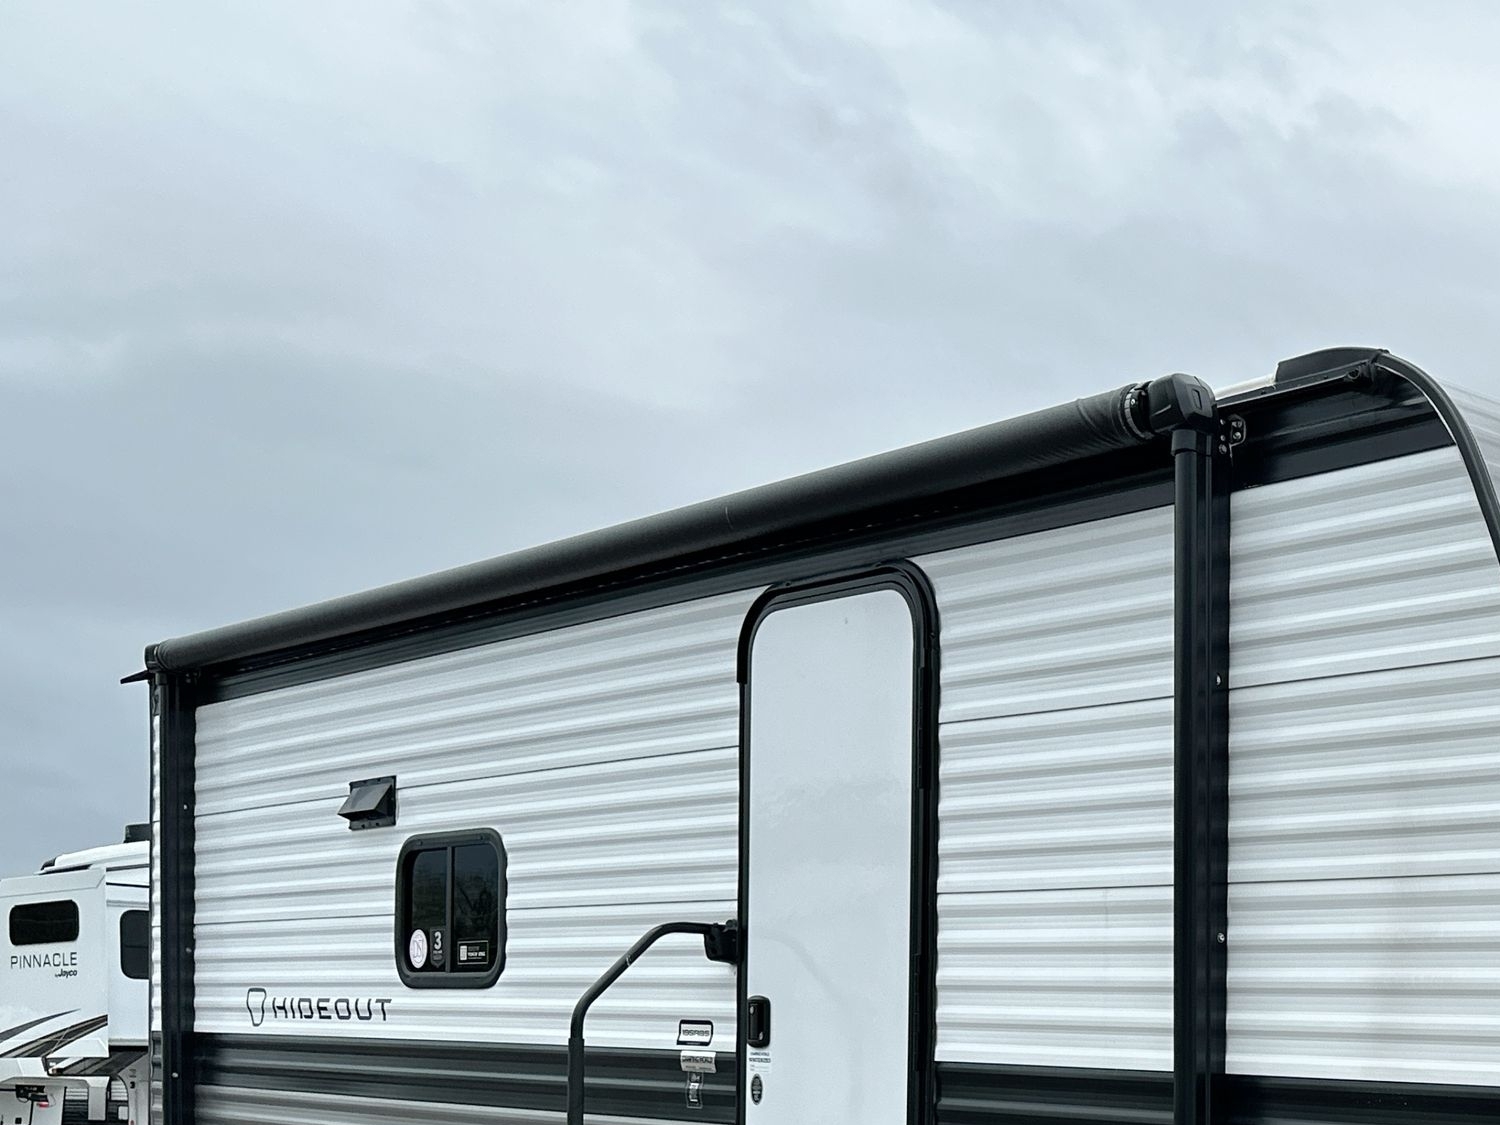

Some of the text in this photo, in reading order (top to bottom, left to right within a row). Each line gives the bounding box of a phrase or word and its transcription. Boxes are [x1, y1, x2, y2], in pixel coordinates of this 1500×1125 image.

[434, 931, 442, 950] 3
[10, 951, 78, 969] PINNACLE
[60, 968, 78, 978] Jayco
[272, 996, 393, 1021] HIDEOUT
